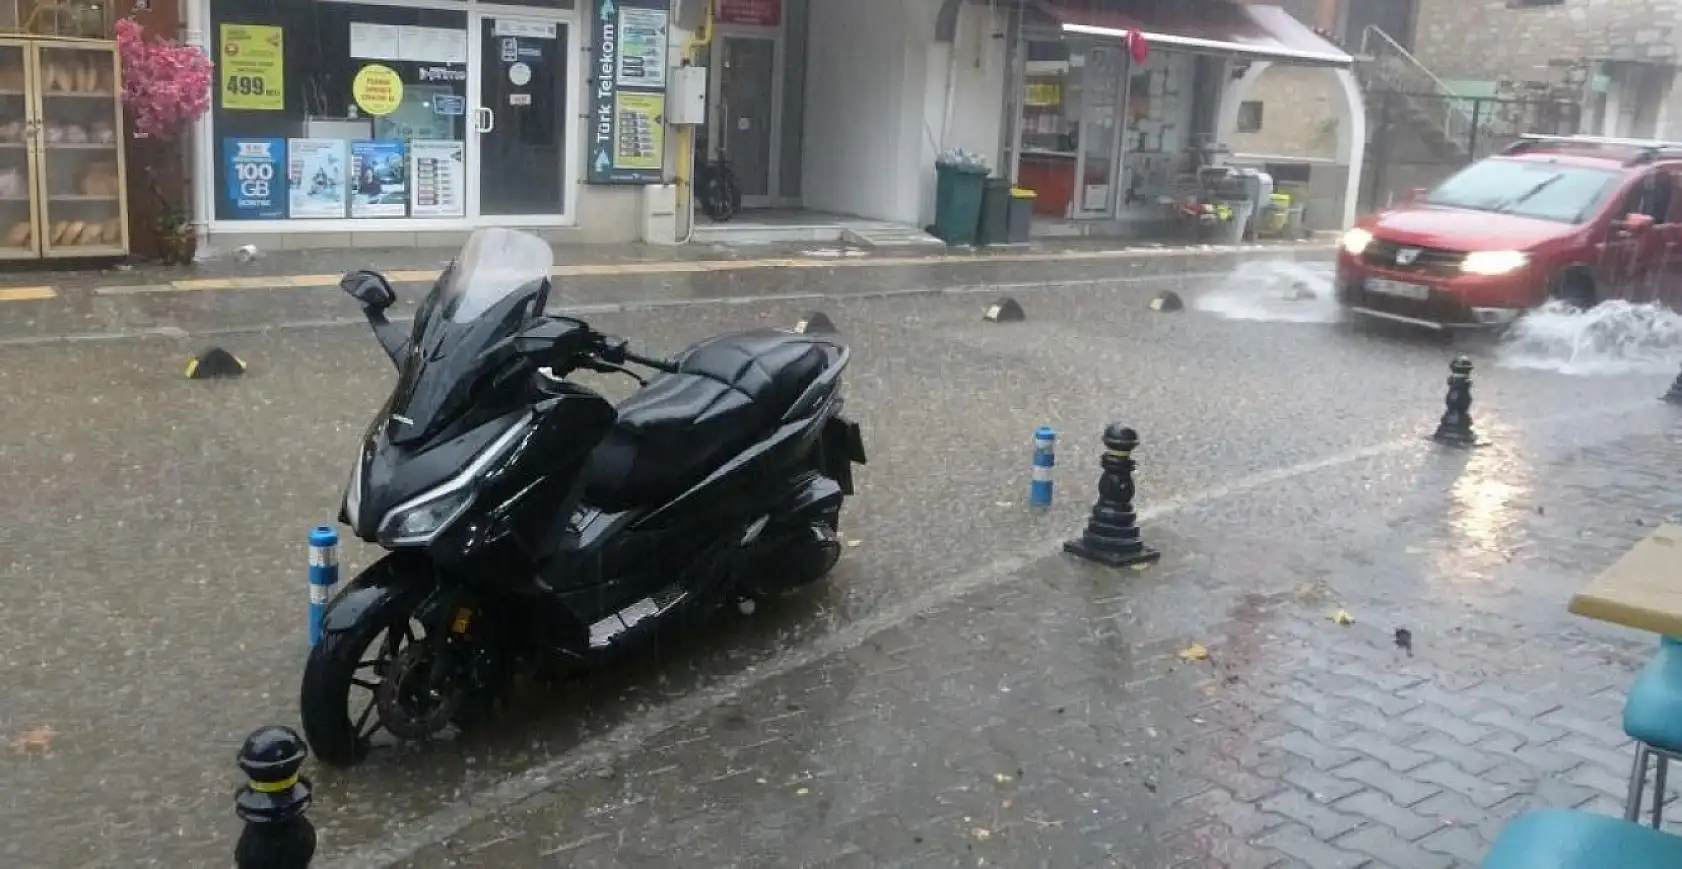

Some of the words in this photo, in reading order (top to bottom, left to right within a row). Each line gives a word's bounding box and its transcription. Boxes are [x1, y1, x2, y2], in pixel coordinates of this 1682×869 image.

[598, 24, 614, 99] Telekom
[227, 76, 264, 95] 499
[596, 105, 611, 143] Türk
[235, 163, 273, 180] 100
[241, 180, 270, 196] GB
